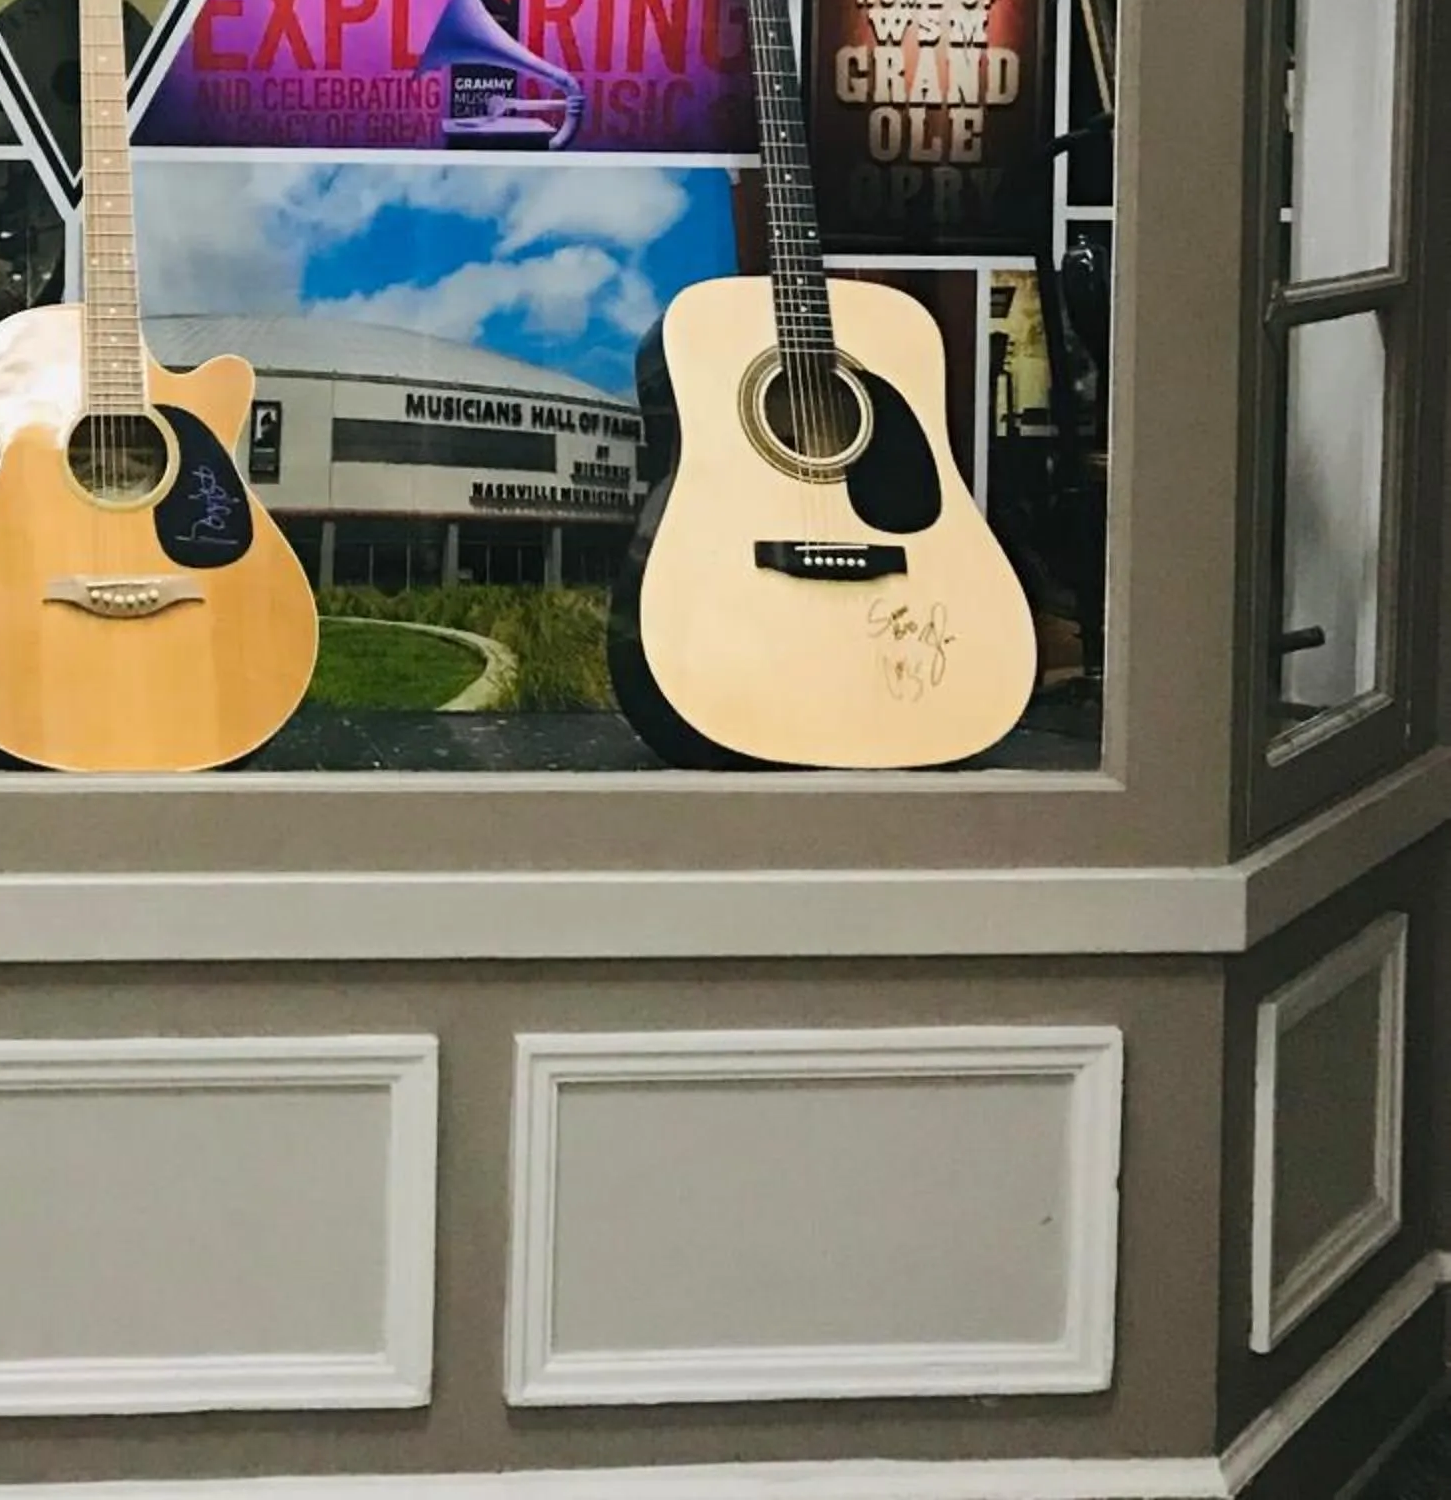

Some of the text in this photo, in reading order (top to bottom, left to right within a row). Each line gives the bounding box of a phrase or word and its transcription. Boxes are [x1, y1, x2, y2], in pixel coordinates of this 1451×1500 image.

[867, 8, 989, 48] WSM
[262, 76, 441, 113] CELEBRATING
[454, 77, 515, 91] GRAMMY
[834, 46, 1020, 105] GRAND
[365, 111, 439, 144] GREAT
[867, 106, 985, 164] OLE
[404, 393, 523, 427] MUSICIANS
[530, 405, 577, 433] HALL
[578, 411, 601, 437] OF
[471, 482, 559, 501] NASHVILLE
